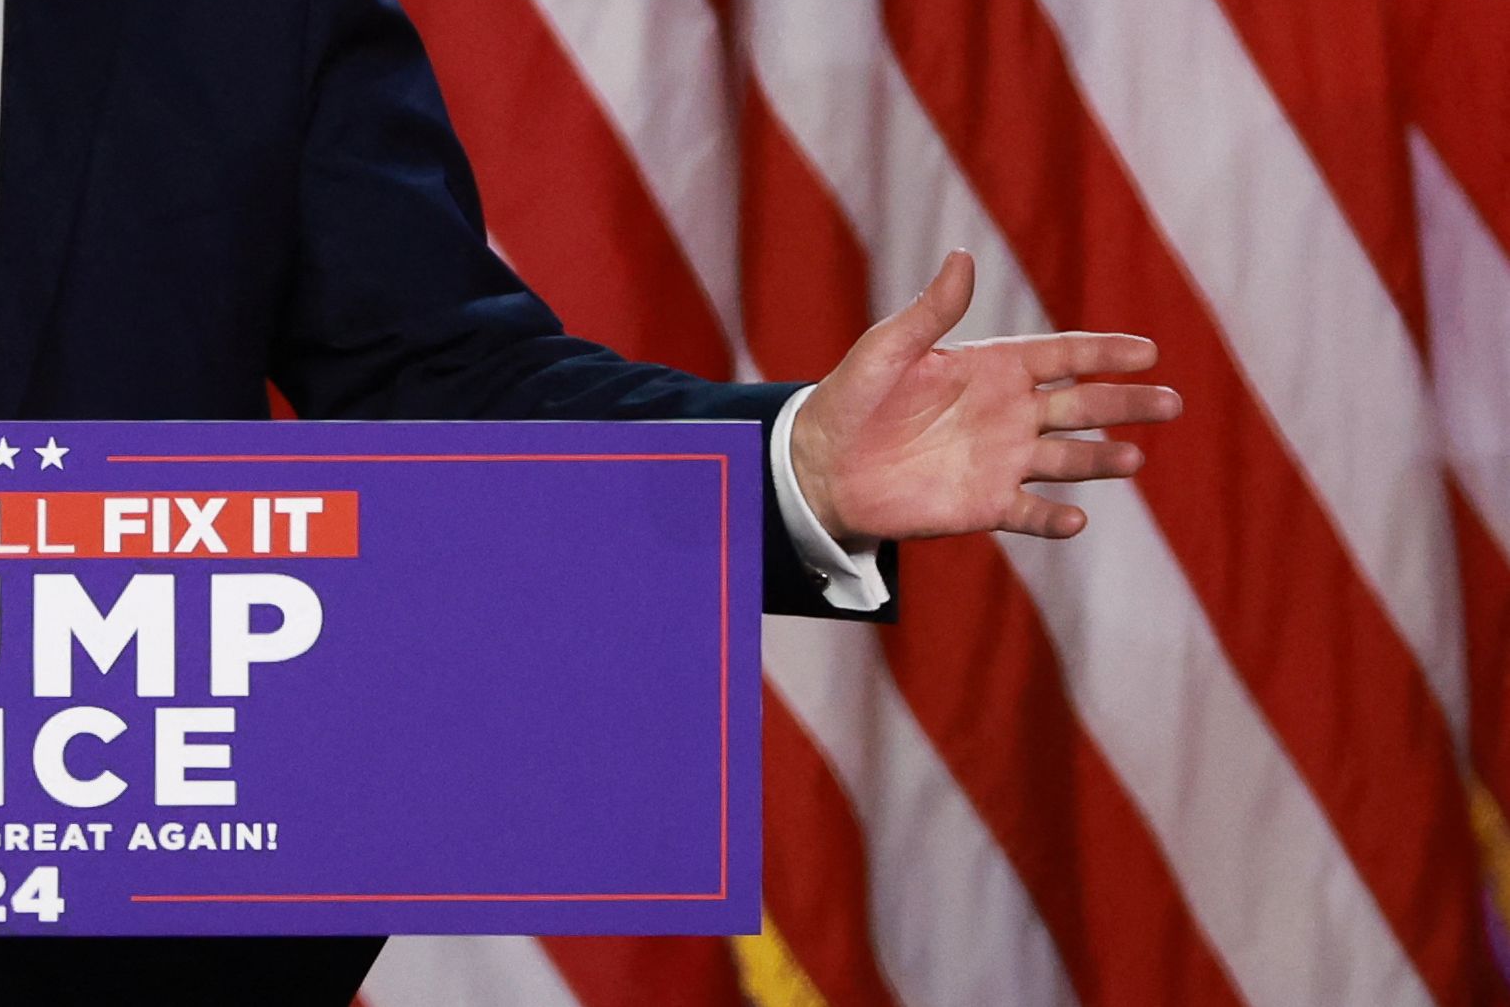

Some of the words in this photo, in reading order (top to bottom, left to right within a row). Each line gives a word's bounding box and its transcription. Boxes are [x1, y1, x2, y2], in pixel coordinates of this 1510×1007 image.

[103, 497, 229, 554] FIX
[253, 497, 324, 554] IT
[128, 822, 278, 852] AGAIN!
